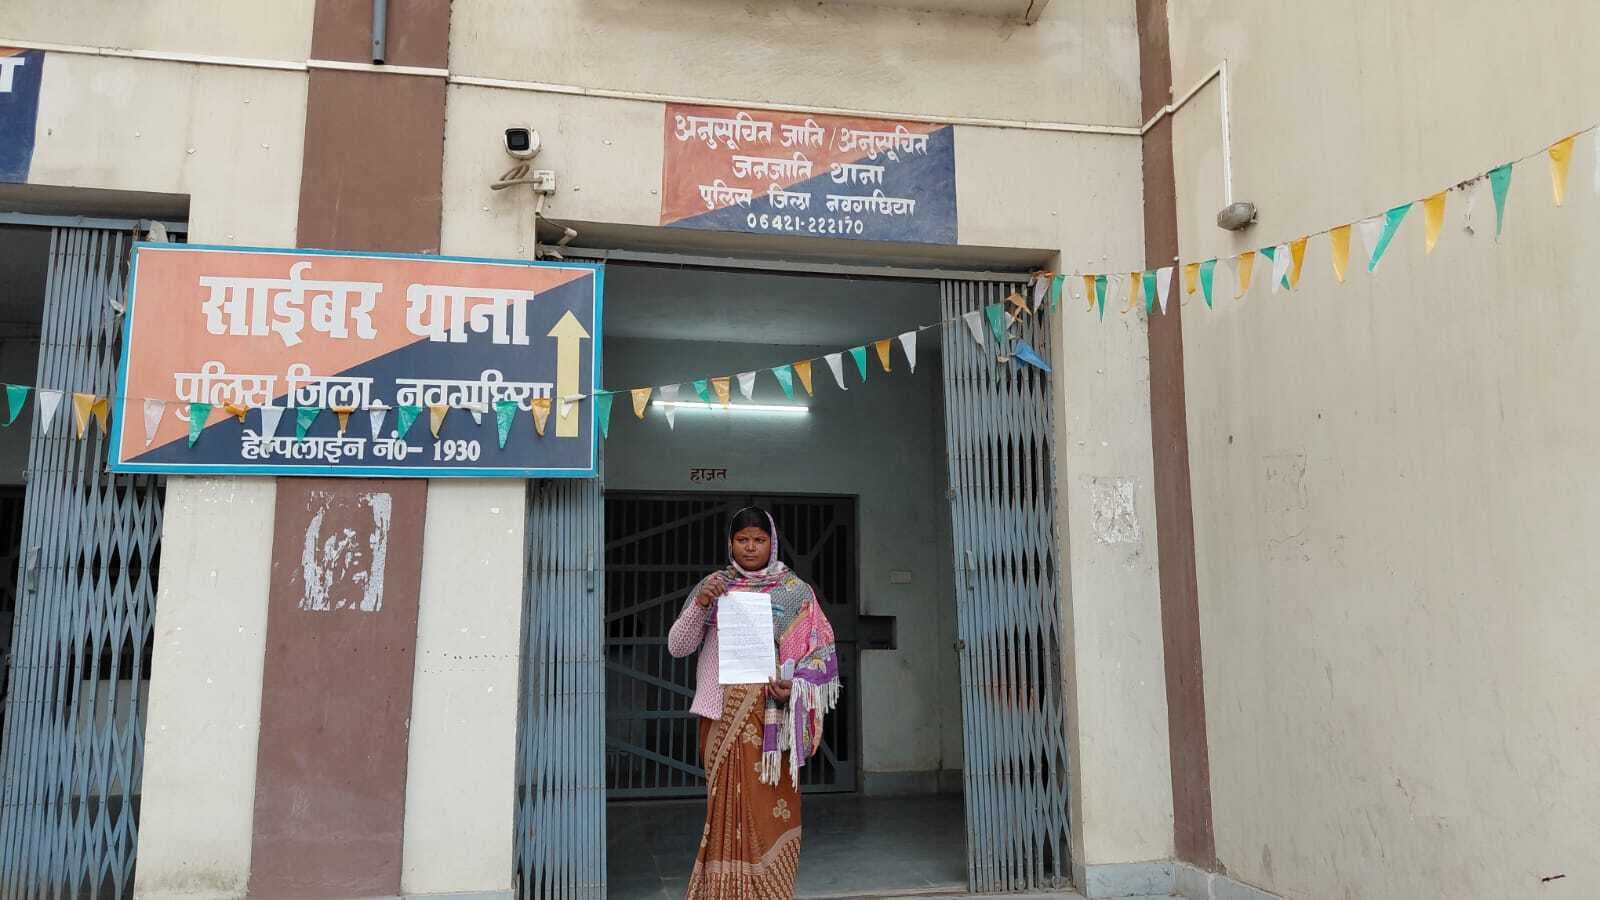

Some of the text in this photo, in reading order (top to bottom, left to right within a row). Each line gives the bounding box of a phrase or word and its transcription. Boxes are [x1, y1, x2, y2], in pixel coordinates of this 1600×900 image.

[674, 111, 773, 150] अनुसूचित
[780, 118, 825, 148] जाति
[732, 152, 885, 186] जनजाति थाना
[698, 179, 753, 210] पुलिस
[768, 183, 811, 210] जिला
[199, 261, 535, 347] साईबर थाना
[174, 360, 277, 422] पुलिस
[433, 439, 481, 462] 1930
